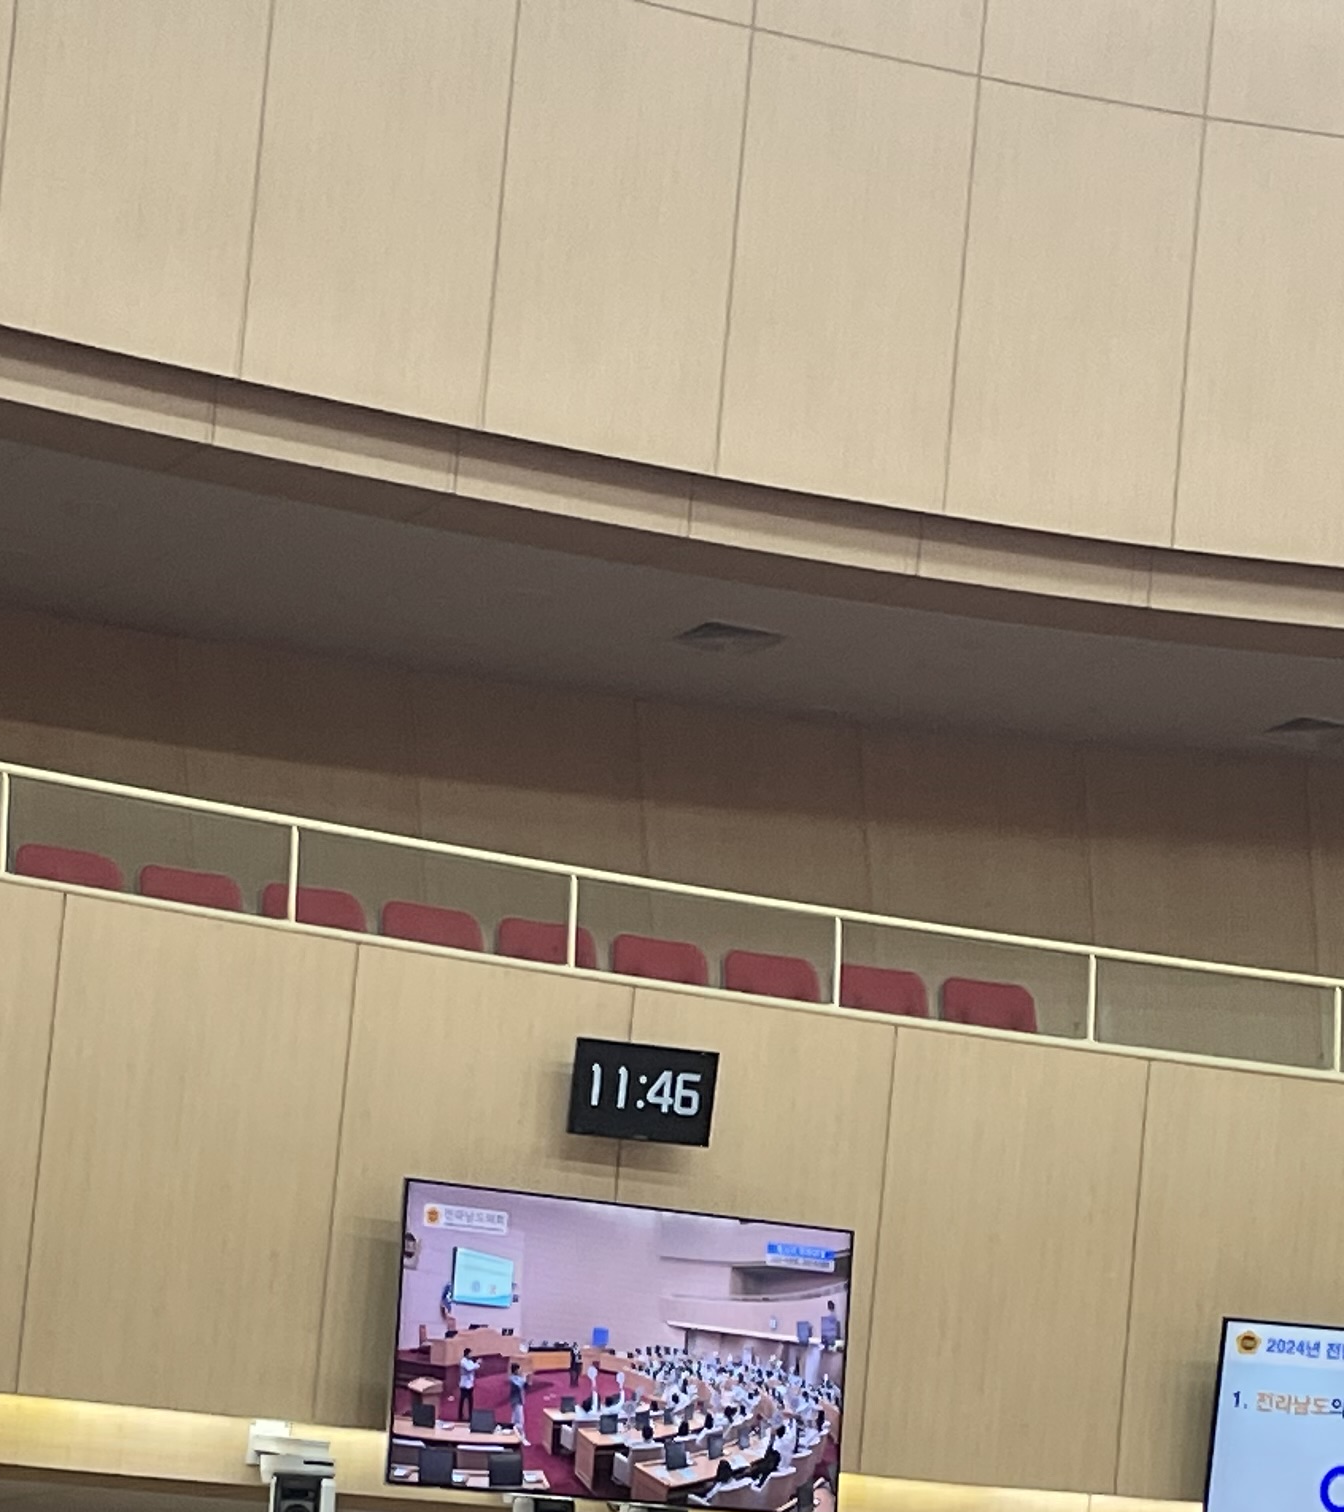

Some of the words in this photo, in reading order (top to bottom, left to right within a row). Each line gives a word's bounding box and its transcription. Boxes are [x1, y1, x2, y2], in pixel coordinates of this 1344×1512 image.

[589, 1063, 702, 1117] 11:46
[1266, 1337, 1320, 1358] 2024년
[1232, 1391, 1248, 1409] 1.
